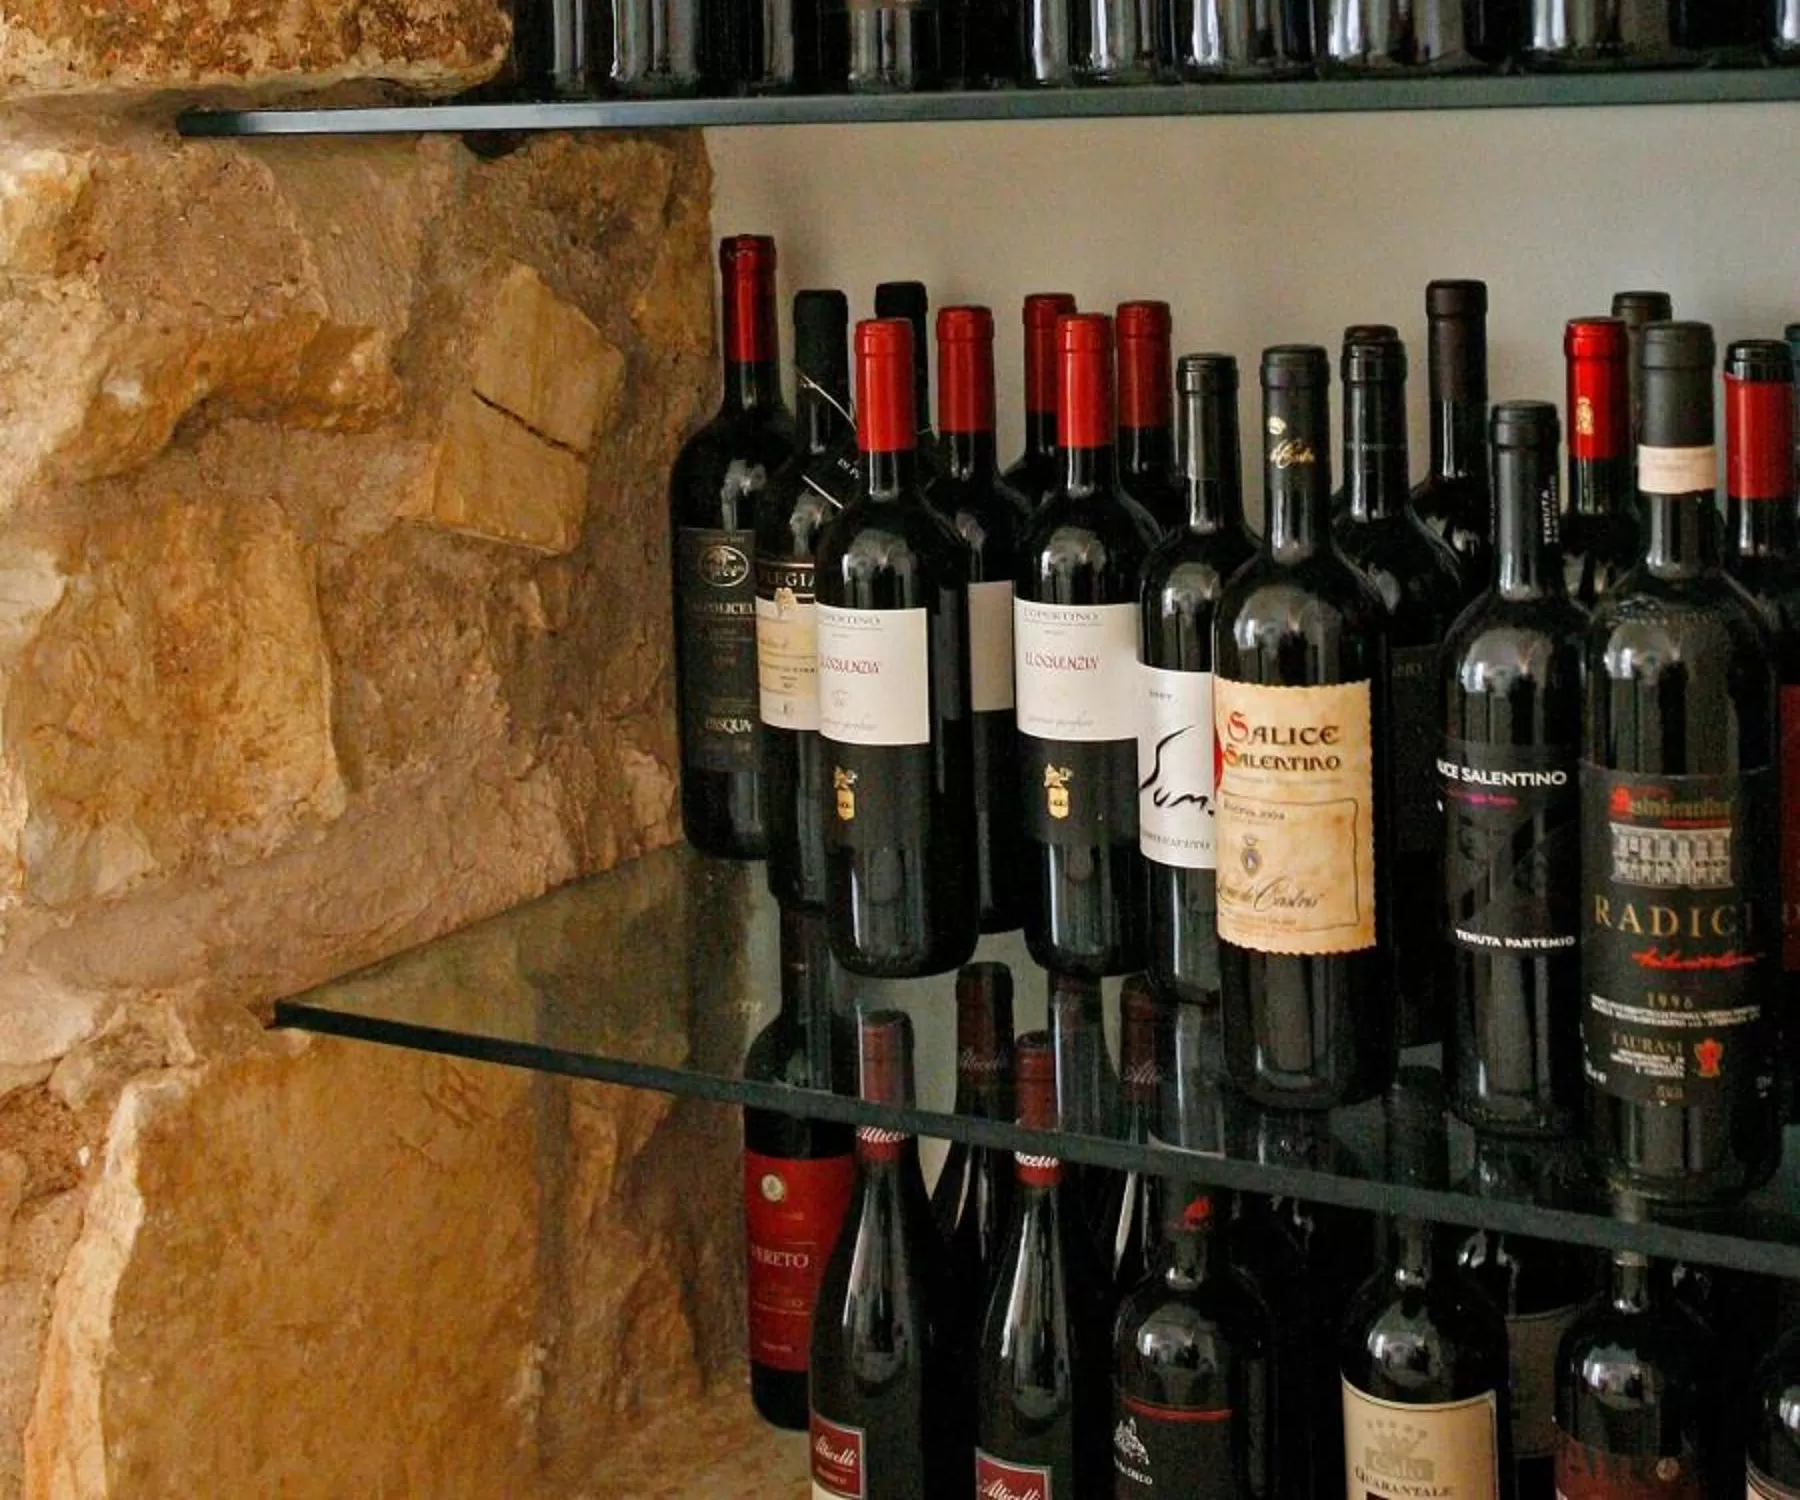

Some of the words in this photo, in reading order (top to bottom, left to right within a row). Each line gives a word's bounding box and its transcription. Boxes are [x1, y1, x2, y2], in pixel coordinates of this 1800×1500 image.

[1461, 767, 1567, 787] SALENTINO
[1594, 894, 1754, 938] RADICI
[1455, 928, 1502, 947] TENUTA
[1504, 935, 1576, 949] PARTEMIO
